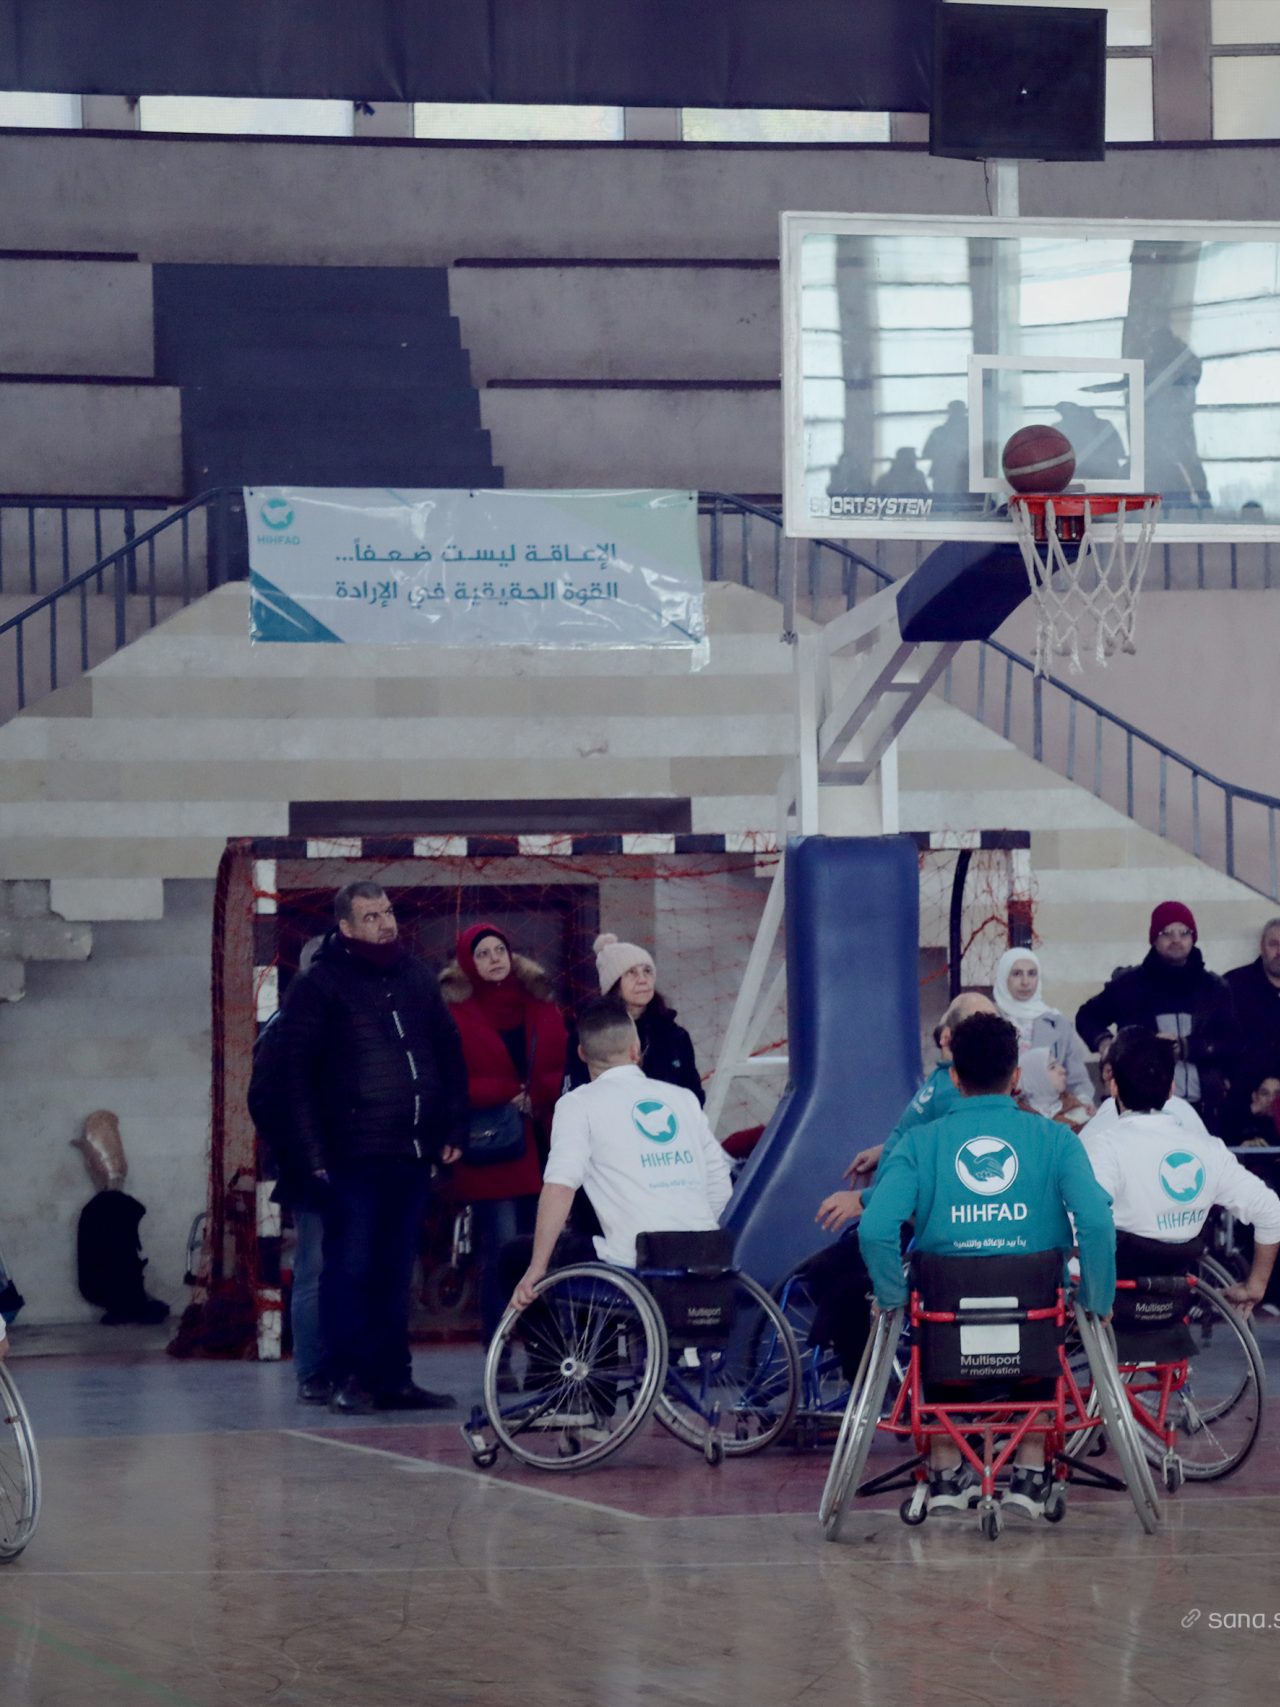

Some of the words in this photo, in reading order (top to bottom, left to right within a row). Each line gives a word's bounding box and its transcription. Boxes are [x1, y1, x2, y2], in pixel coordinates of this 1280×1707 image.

[442, 544, 516, 568] ليست
[525, 543, 616, 570] الإعاقة
[336, 580, 398, 608] الإرادة
[408, 581, 445, 609] في
[454, 581, 555, 607] الحقيقية
[562, 581, 619, 607] القوة
[640, 1150, 694, 1168] HIHFAD
[951, 1203, 1028, 1223] HIHFAD
[961, 1355, 1021, 1367] Multisport
